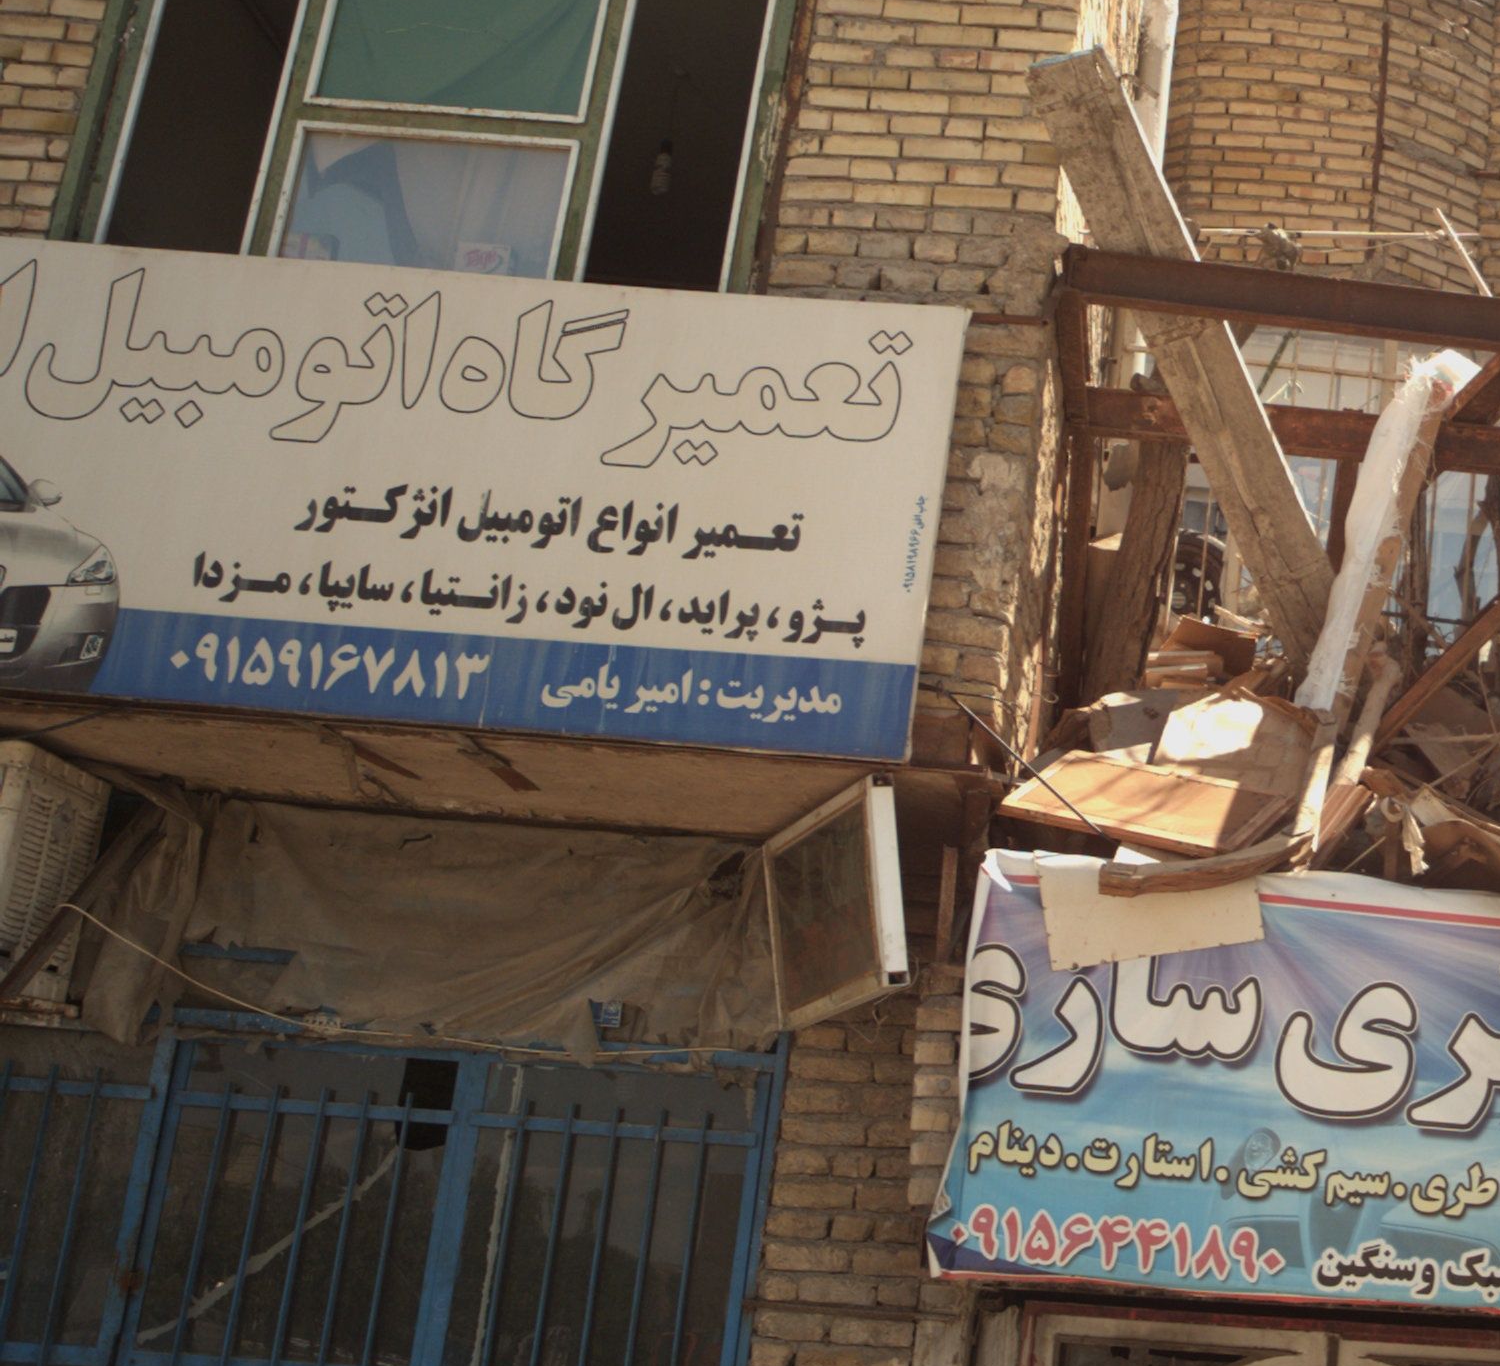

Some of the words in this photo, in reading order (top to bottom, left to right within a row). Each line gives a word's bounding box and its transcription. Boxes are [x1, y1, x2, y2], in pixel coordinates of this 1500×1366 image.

[25, 267, 442, 443] اتومبیل
[294, 483, 454, 540] انژکتور
[457, 488, 583, 550] اتومبیل
[586, 499, 680, 556] انواع
[681, 512, 805, 560] تعمیر
[194, 550, 292, 603] مزدا
[169, 632, 491, 700] ۰۹۱۵۹۱۶۷۸۱۳
[624, 668, 693, 714] امیر
[967, 1119, 1063, 1178] دینام
[1325, 1168, 1391, 1206] سیم
[951, 1203, 1286, 1283] ۰۹۱۵۶۴۴۱۸۹۰
